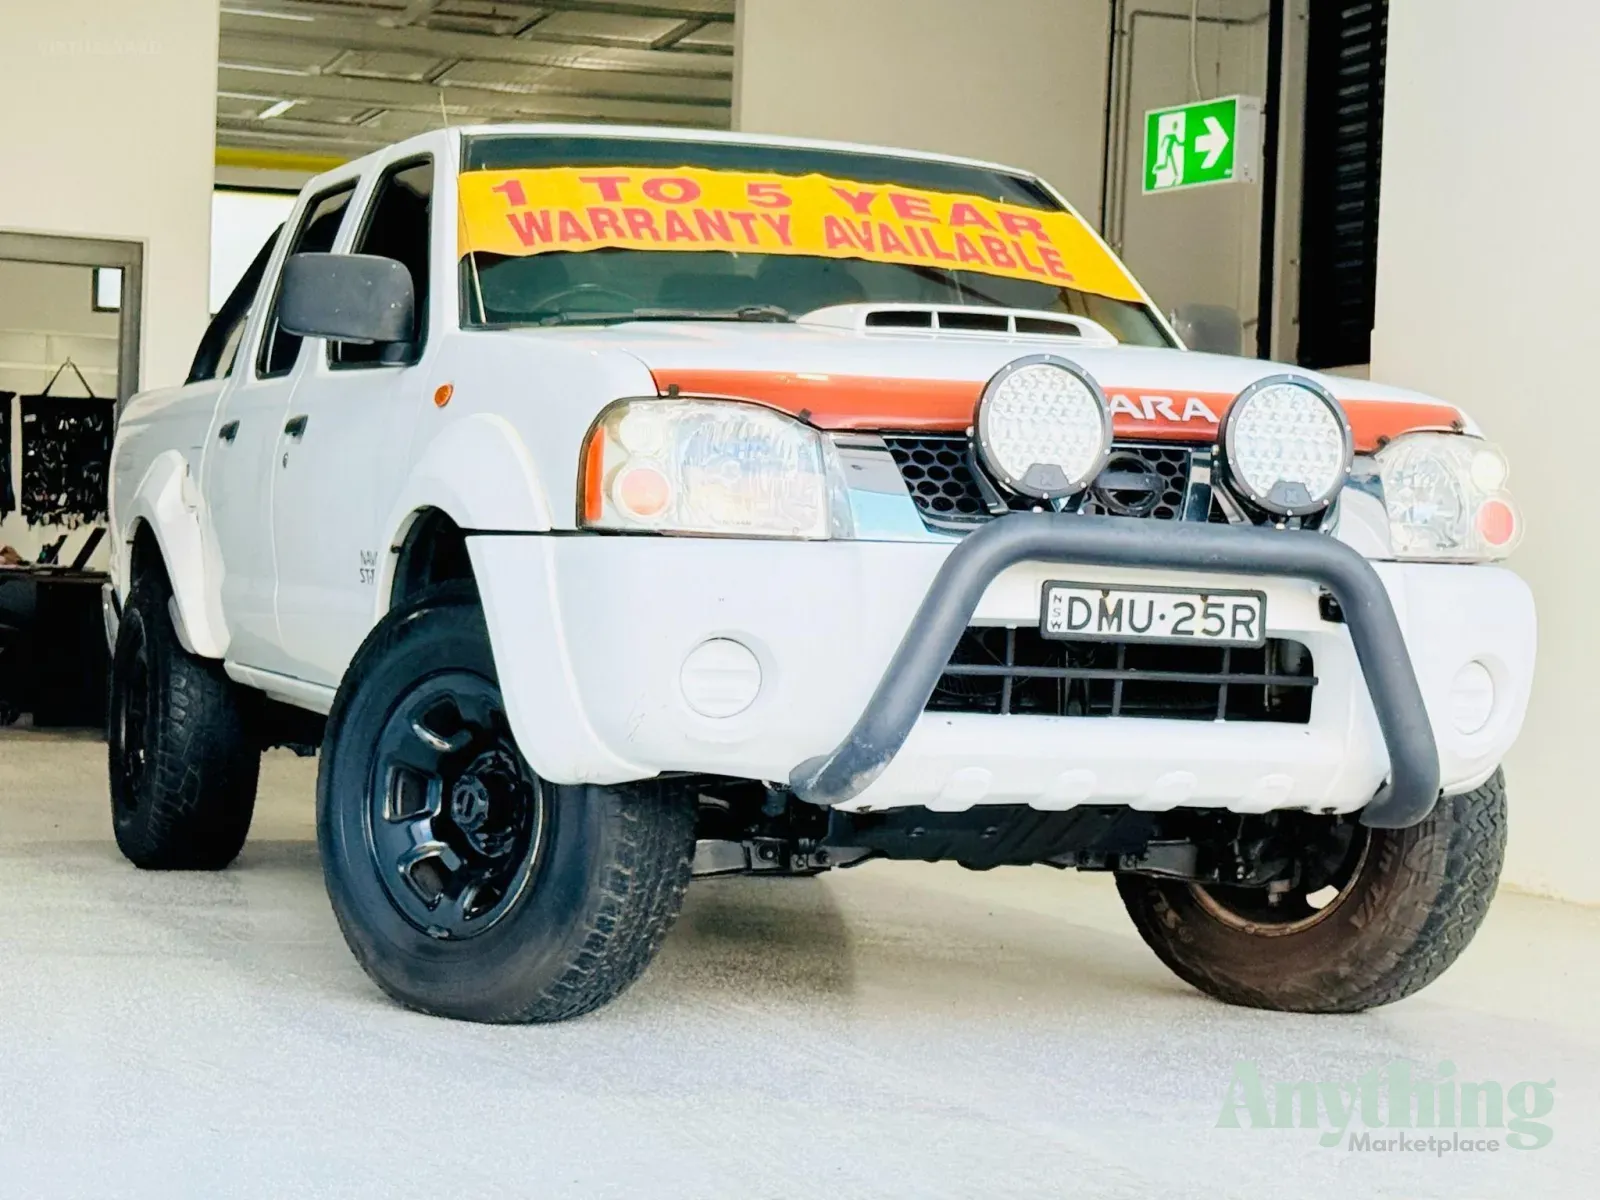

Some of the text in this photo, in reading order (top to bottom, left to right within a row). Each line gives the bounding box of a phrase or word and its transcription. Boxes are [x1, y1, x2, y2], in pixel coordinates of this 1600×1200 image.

[491, 176, 1053, 244] 1 TO 5 YEAR
[506, 207, 1074, 281] WARRANTY AVAILABLE
[1109, 393, 1220, 423] ARA
